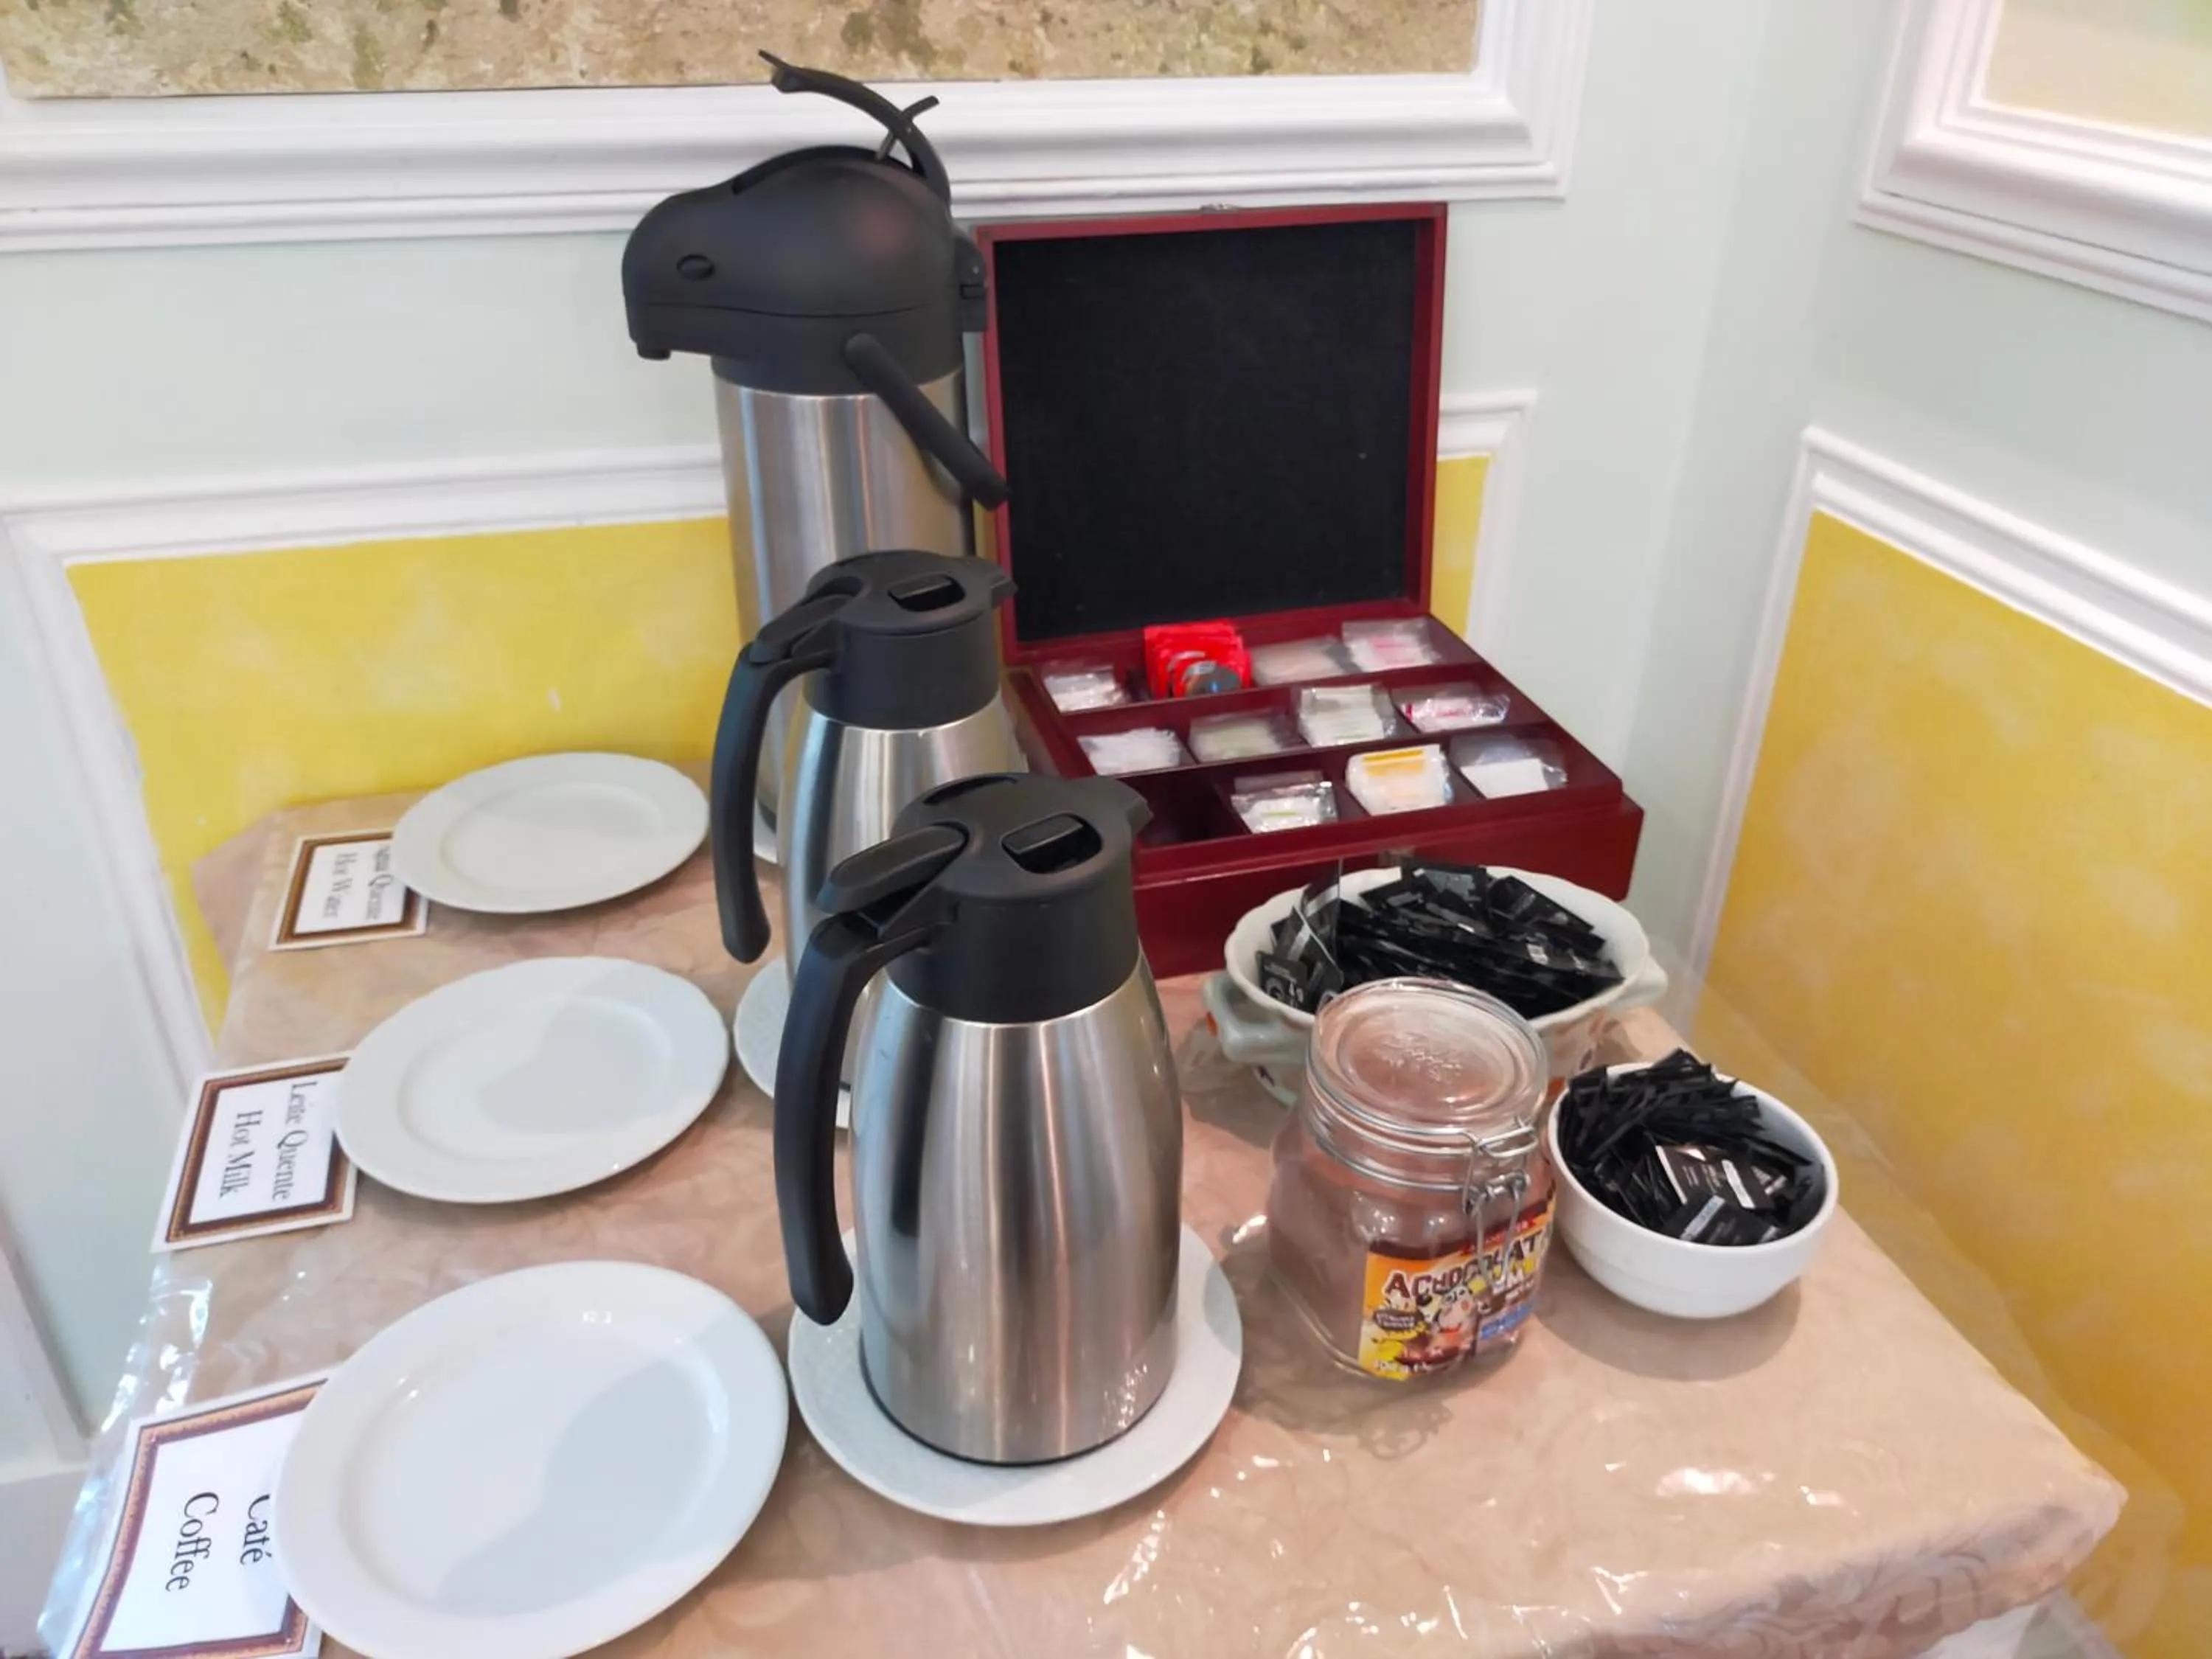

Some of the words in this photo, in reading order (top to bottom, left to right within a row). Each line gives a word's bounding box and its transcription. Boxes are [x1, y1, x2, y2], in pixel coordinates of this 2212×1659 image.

[285, 1081, 318, 1125] Leite
[231, 1110, 263, 1147] Hot
[220, 1150, 256, 1198] Milk
[272, 1130, 309, 1201] Quente
[164, 1492, 220, 1592] Coffee
